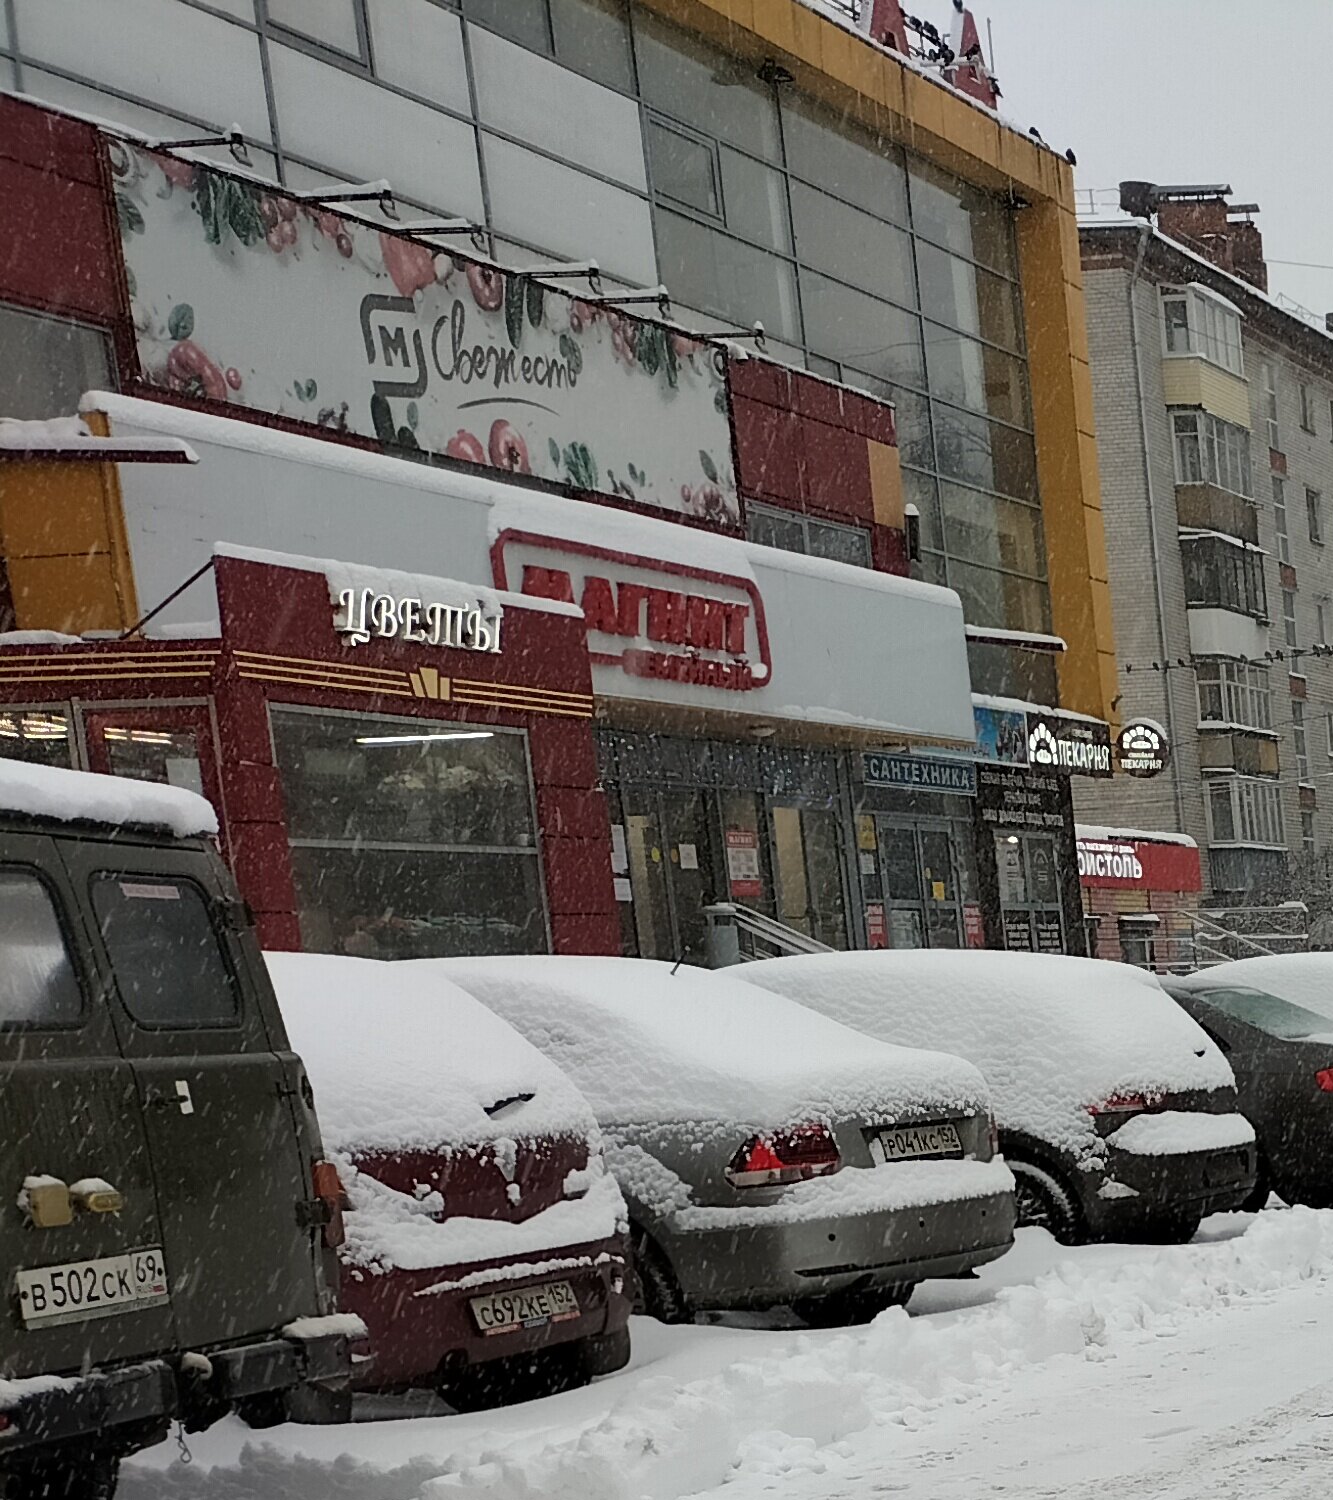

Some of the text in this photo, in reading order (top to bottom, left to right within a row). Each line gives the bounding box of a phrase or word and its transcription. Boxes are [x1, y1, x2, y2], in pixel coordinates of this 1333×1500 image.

[431, 299, 579, 392] Свежесть
[339, 587, 503, 654] ЦВЕТЫ
[869, 758, 970, 788] САНТЕХНИКА
[1057, 739, 1110, 771] ПЕКАРНЯ
[1119, 758, 1163, 770] ПЕКАРНЯ
[886, 1126, 957, 1156] Р041КС 152
[31, 1254, 157, 1312] В502СК 69
[479, 1294, 551, 1326] С692КЕ
[547, 1283, 573, 1305] 152
